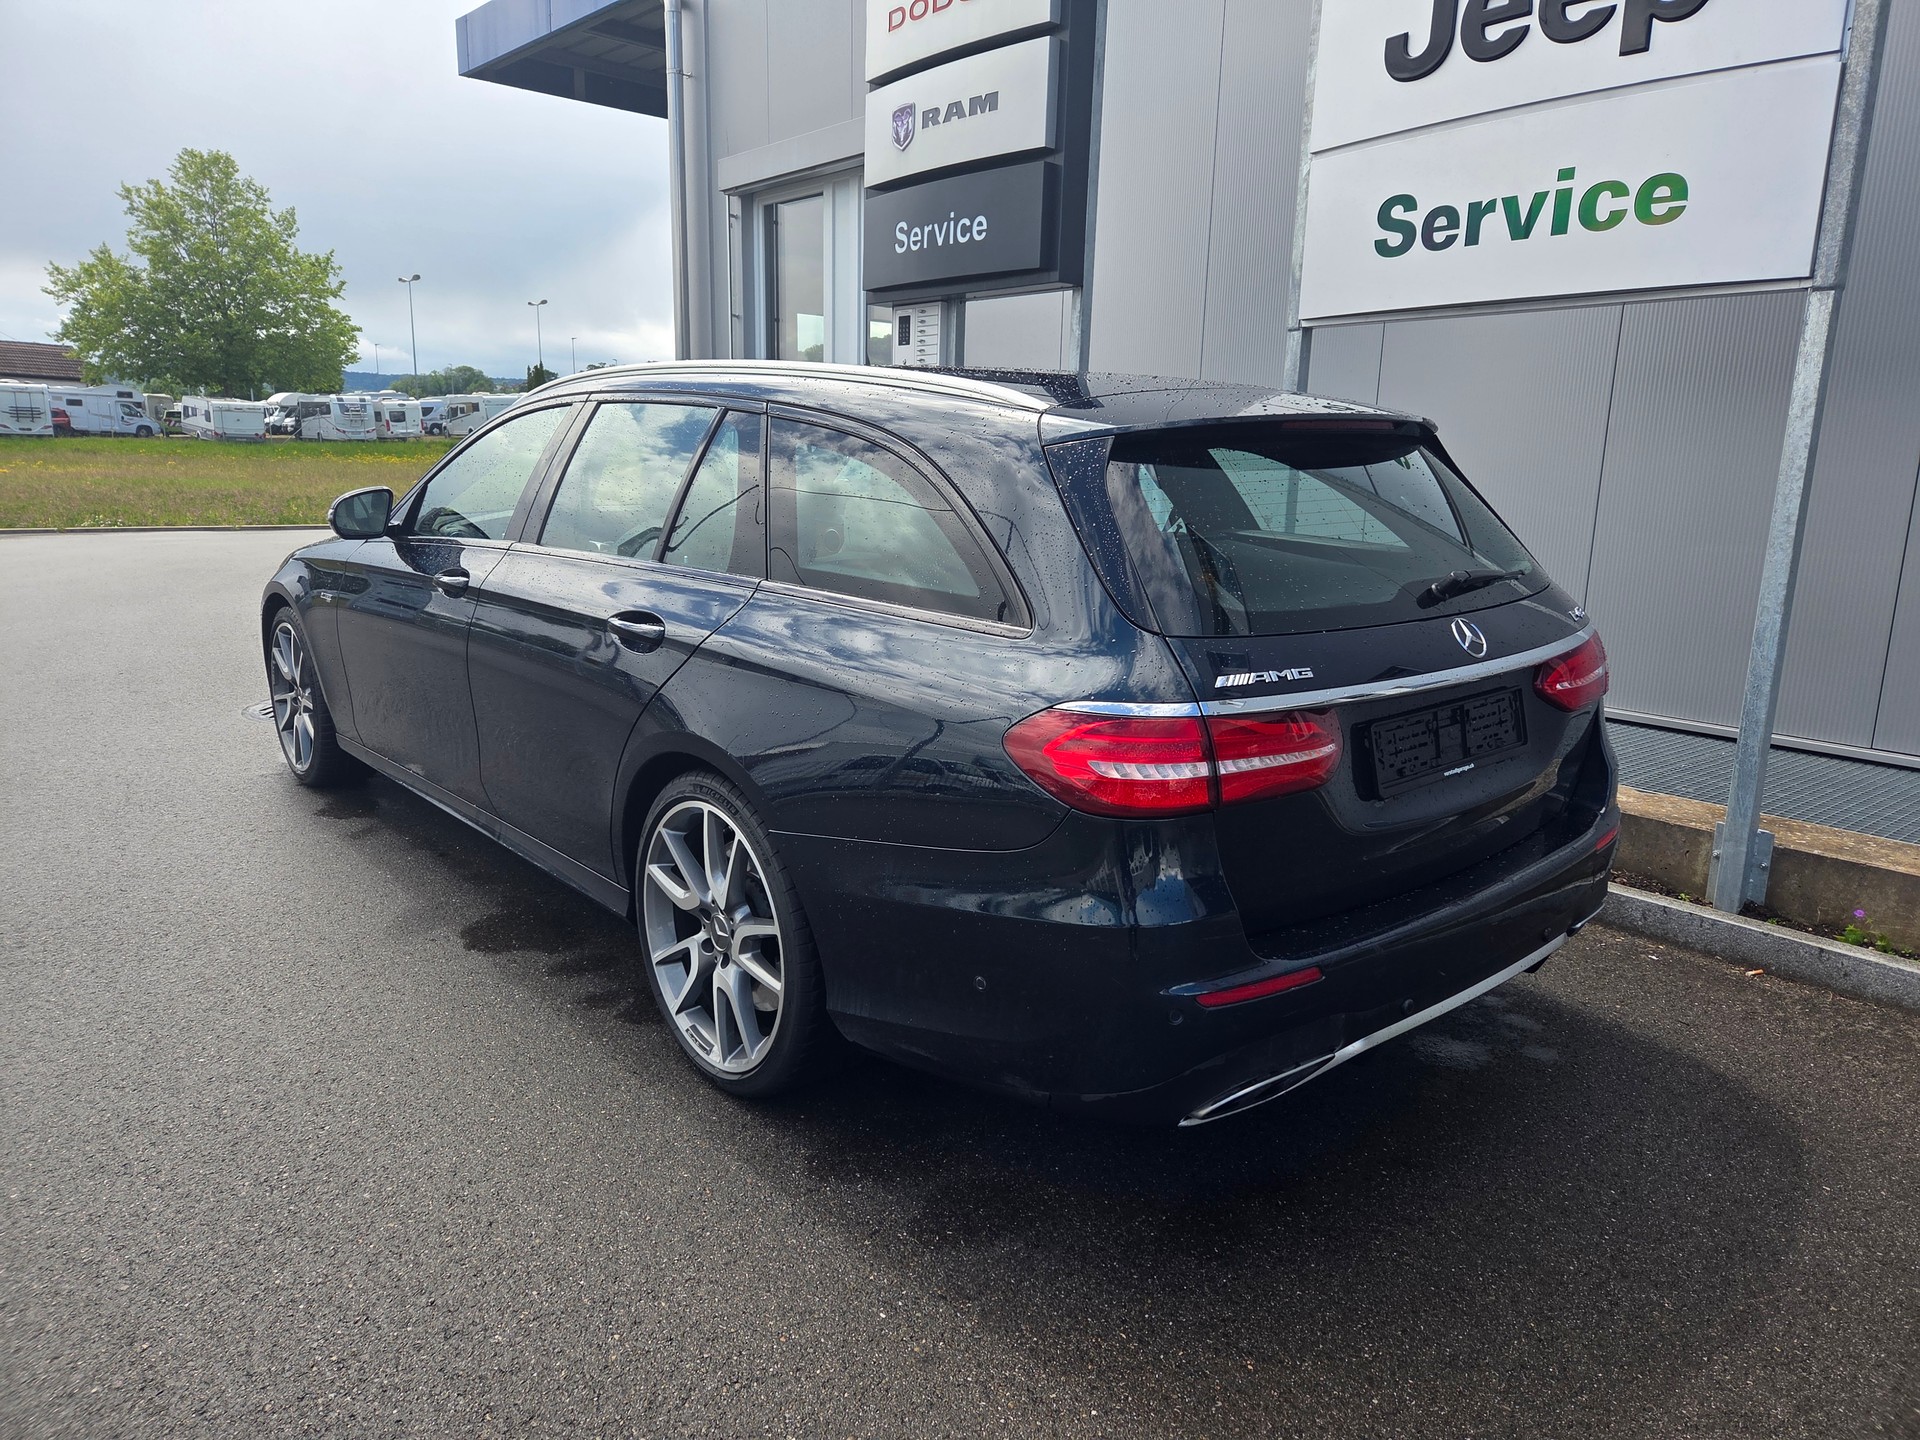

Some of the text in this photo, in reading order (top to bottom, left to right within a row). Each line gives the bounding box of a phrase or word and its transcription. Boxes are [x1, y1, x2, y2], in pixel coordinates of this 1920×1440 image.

[921, 91, 999, 130] RAM
[894, 211, 988, 254] Service
[1374, 167, 1689, 258] Service
